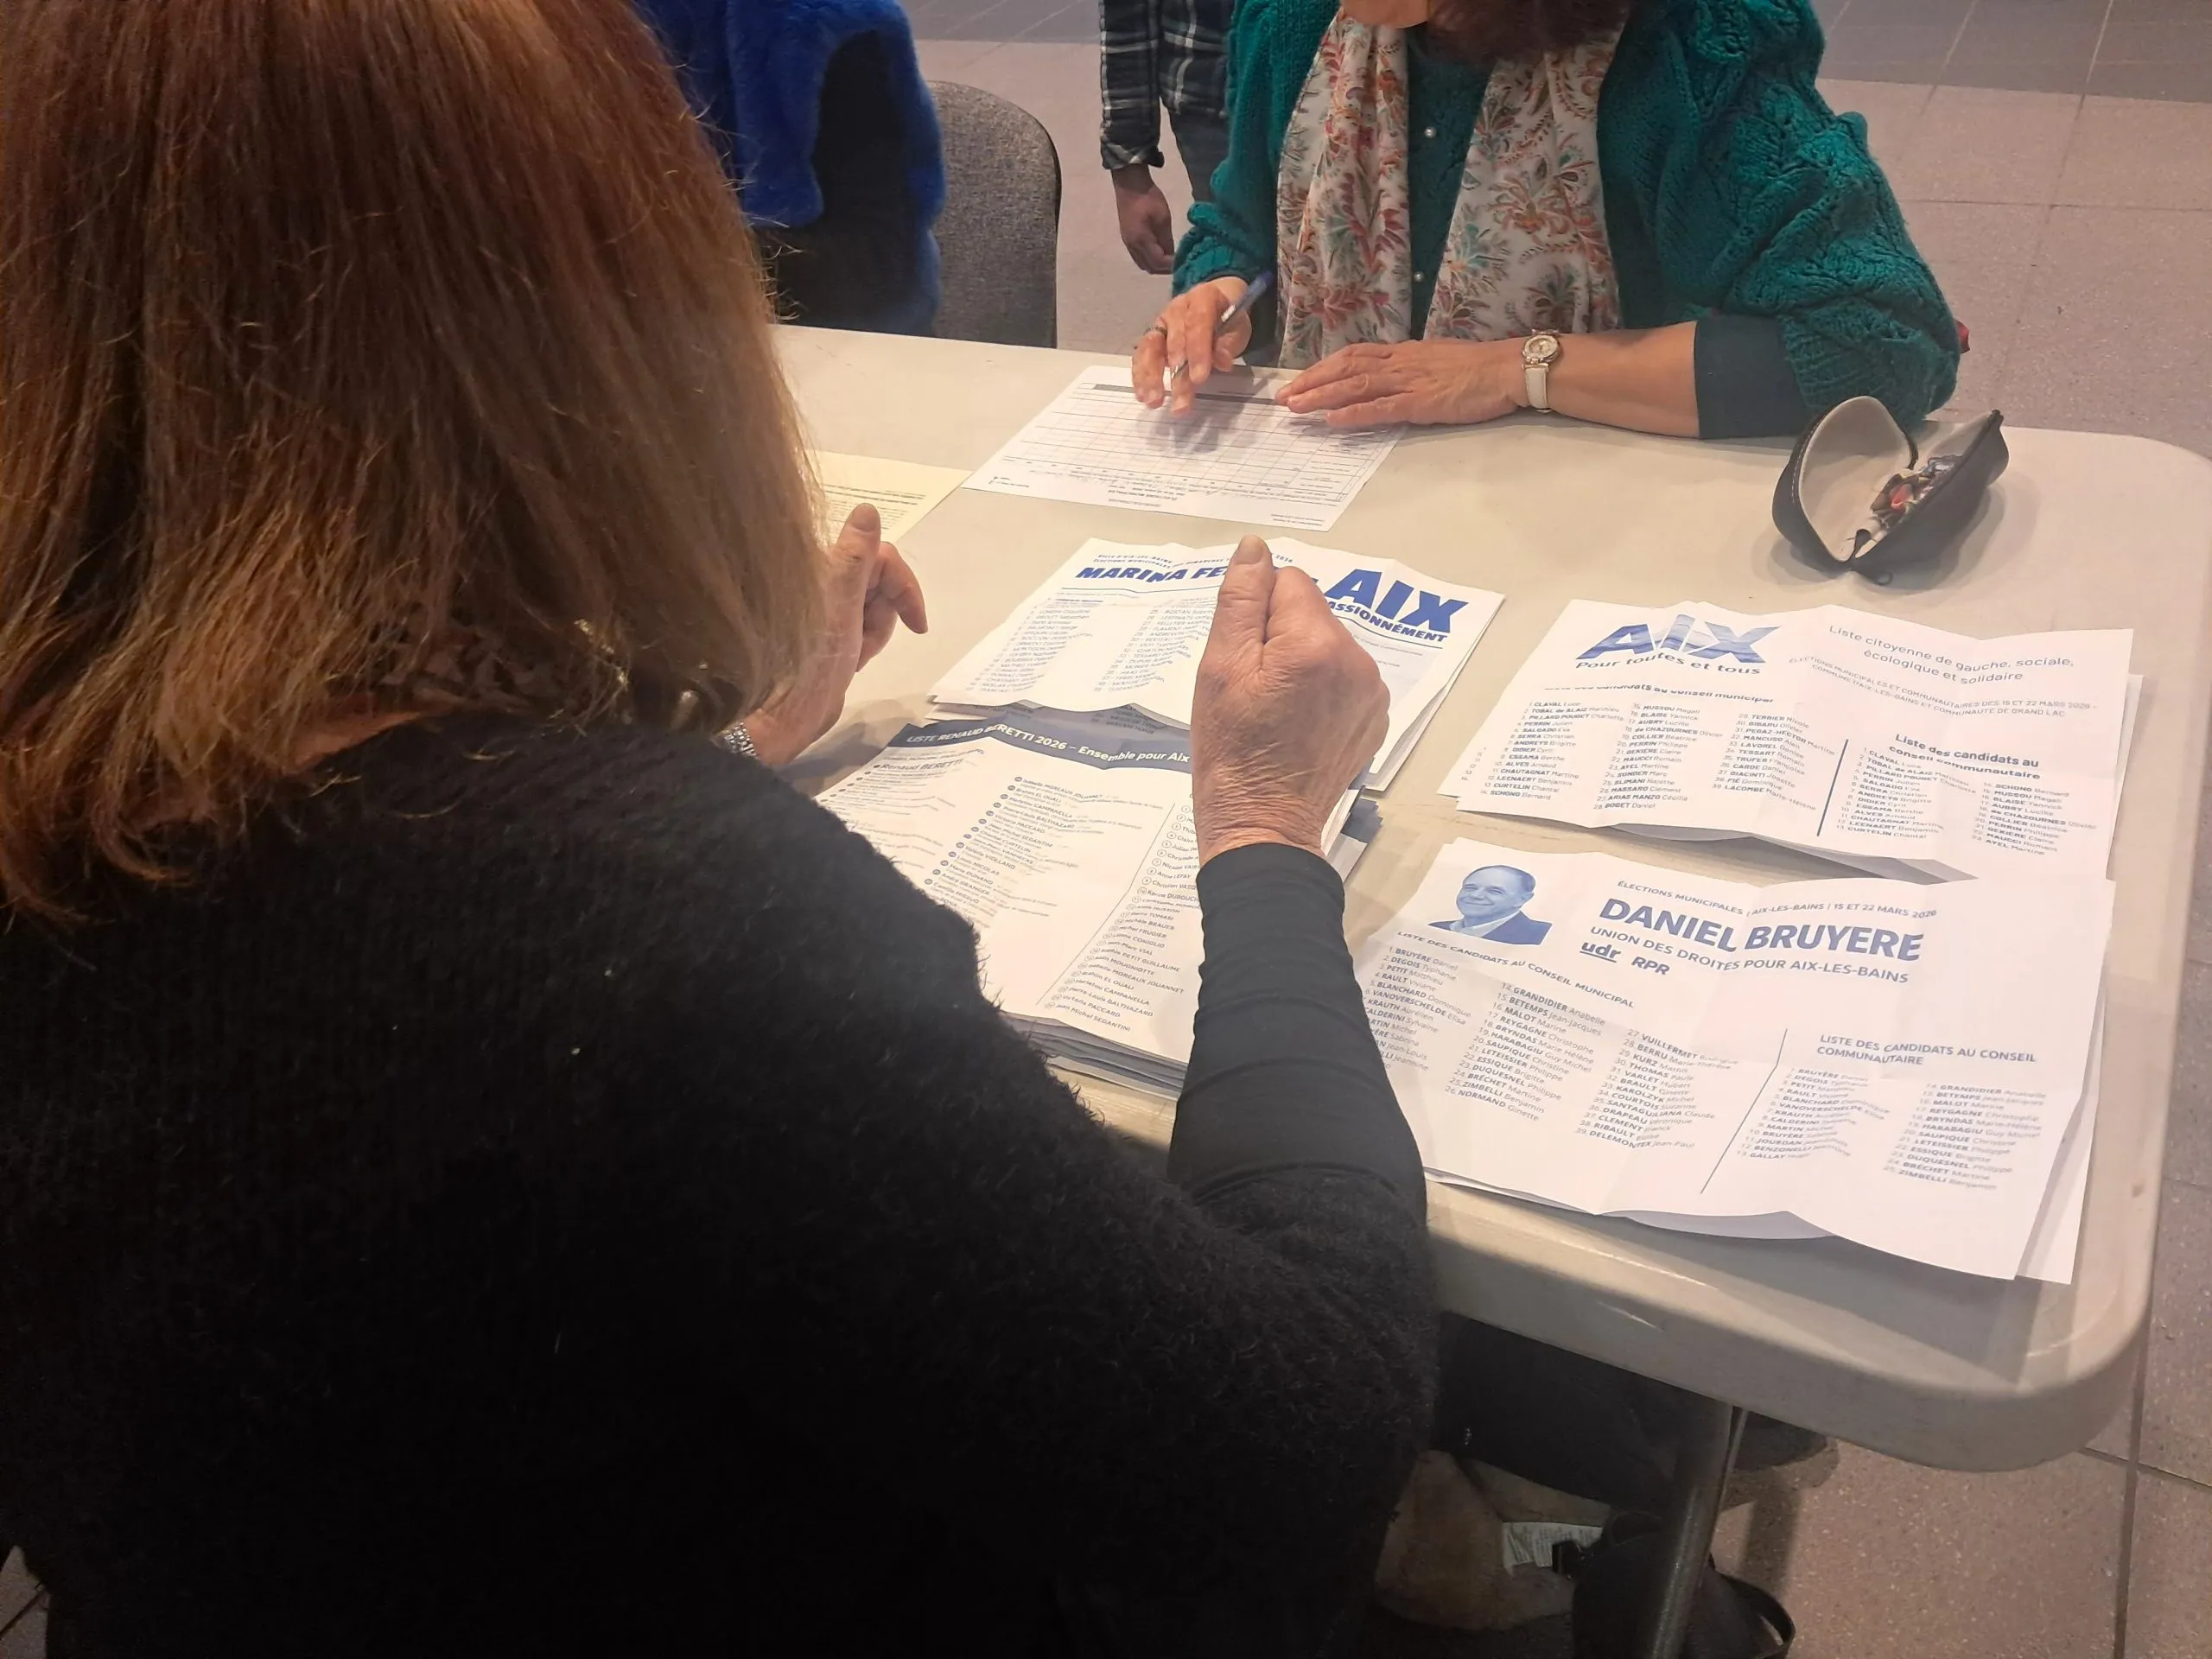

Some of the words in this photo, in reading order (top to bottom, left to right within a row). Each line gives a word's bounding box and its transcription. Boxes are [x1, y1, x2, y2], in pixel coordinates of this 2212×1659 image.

[1075, 567, 1189, 583] MARINA
[1324, 569, 1469, 632] AIX
[1327, 601, 1448, 643] ASSIONNÉMENT
[1575, 613, 1781, 664] AIX
[1829, 625, 1863, 641] Liste
[1865, 637, 1933, 660] citoyenne
[1936, 655, 1953, 666] de
[1575, 659, 1621, 670] Pour
[1626, 651, 1685, 665] toutes
[1690, 660, 1711, 671] et
[1718, 664, 1761, 675] tous
[1864, 649, 1940, 677] écologique
[1942, 671, 1957, 682] et
[1961, 672, 2024, 685] solidaire
[1811, 663, 1852, 683] COMMUNE
[2011, 708, 2044, 716] GRAND
[1834, 664, 1888, 688] MUNICIPALES
[1889, 683, 1901, 692] ET
[1901, 687, 1980, 709] COMMUNAUTAIRES
[1786, 716, 1810, 729] Nicole
[938, 728, 983, 741] RENAUD
[984, 723, 1035, 742] BERETTI
[1035, 734, 1068, 751] 2026
[1077, 745, 1135, 763] Ensemble
[1136, 751, 1166, 762] pour
[1167, 751, 1191, 764] Aix
[1895, 733, 1927, 750] Liste
[1929, 746, 1951, 758] des
[1953, 750, 2020, 766] candidats
[2022, 759, 2040, 768] au
[880, 762, 918, 771] Renaud
[1888, 745, 1935, 762] conseil
[1936, 758, 2042, 780] communautaire
[1617, 880, 1675, 899] ÉLECTIONS
[1675, 893, 1743, 916] MUNICIPALES
[1751, 902, 1825, 917] AIX-LES-BAINS
[1877, 905, 1909, 917] MARS
[1599, 897, 1738, 953] DANIEL
[1744, 925, 1925, 963] BRUYERE
[1390, 956, 1421, 969] DEGOIS
[1580, 941, 1622, 959] udr
[1631, 956, 1671, 976] RPR
[1590, 925, 1641, 945] UNION
[1643, 938, 1675, 956] DES
[1676, 948, 1740, 972] DROITES
[1744, 959, 1787, 969] POUR
[1789, 960, 1910, 984] AIX-LES-BAINS
[1382, 972, 1408, 984] RAULT
[1397, 931, 1426, 943] LISTE
[1427, 938, 1448, 950] DES
[1449, 945, 1509, 967] CANDIDATS
[1510, 959, 1527, 969] AU
[1528, 963, 1573, 988] CONSEIL
[1575, 982, 1636, 1009] MUNICIPAL
[1376, 981, 1427, 1000] BLANCHARD
[1088, 1002, 1122, 1019] PACCARD
[1372, 989, 1447, 1018] VANOVERSCHELDE
[1503, 1006, 1537, 1023] MALOT
[1509, 995, 1549, 1017] BETEMPS
[1513, 986, 1569, 1014] GRANDIDIER
[1569, 1007, 1606, 1027] Anabelle
[1495, 1023, 1538, 1045] BRYNDAS
[1499, 1014, 1548, 1038] REYGAGNE
[1485, 1039, 1531, 1061] SAUPIQUE
[1531, 1055, 1570, 1076] Christine
[1491, 1031, 1544, 1056] HARABAGIU
[1544, 1051, 1561, 1064] Guy
[1563, 1058, 1592, 1074] Michel
[1637, 1043, 1669, 1061] BERRU
[1641, 1033, 1699, 1060] VUILLERMET
[1816, 1046, 1924, 1066] COMMUNAUTAIRE
[1820, 1033, 1853, 1047] LISTE
[1856, 1039, 1880, 1052] DES
[1883, 1042, 1955, 1056] CANDIDATS
[1956, 1046, 1977, 1058] AU
[1979, 1049, 2037, 1063] CONSEIL
[1476, 1056, 1514, 1074] ESSIQUE
[1629, 1062, 1670, 1079] THOMAS
[1632, 1052, 1660, 1068] KURZ
[1471, 1064, 1527, 1088] DUQUESNEL
[1624, 1071, 1660, 1084] VARLET
[1457, 1089, 1507, 1109] NORMAND
[1462, 1081, 1503, 1098] ZIMBELLI
[1611, 1092, 1660, 1111] COURTOIS
